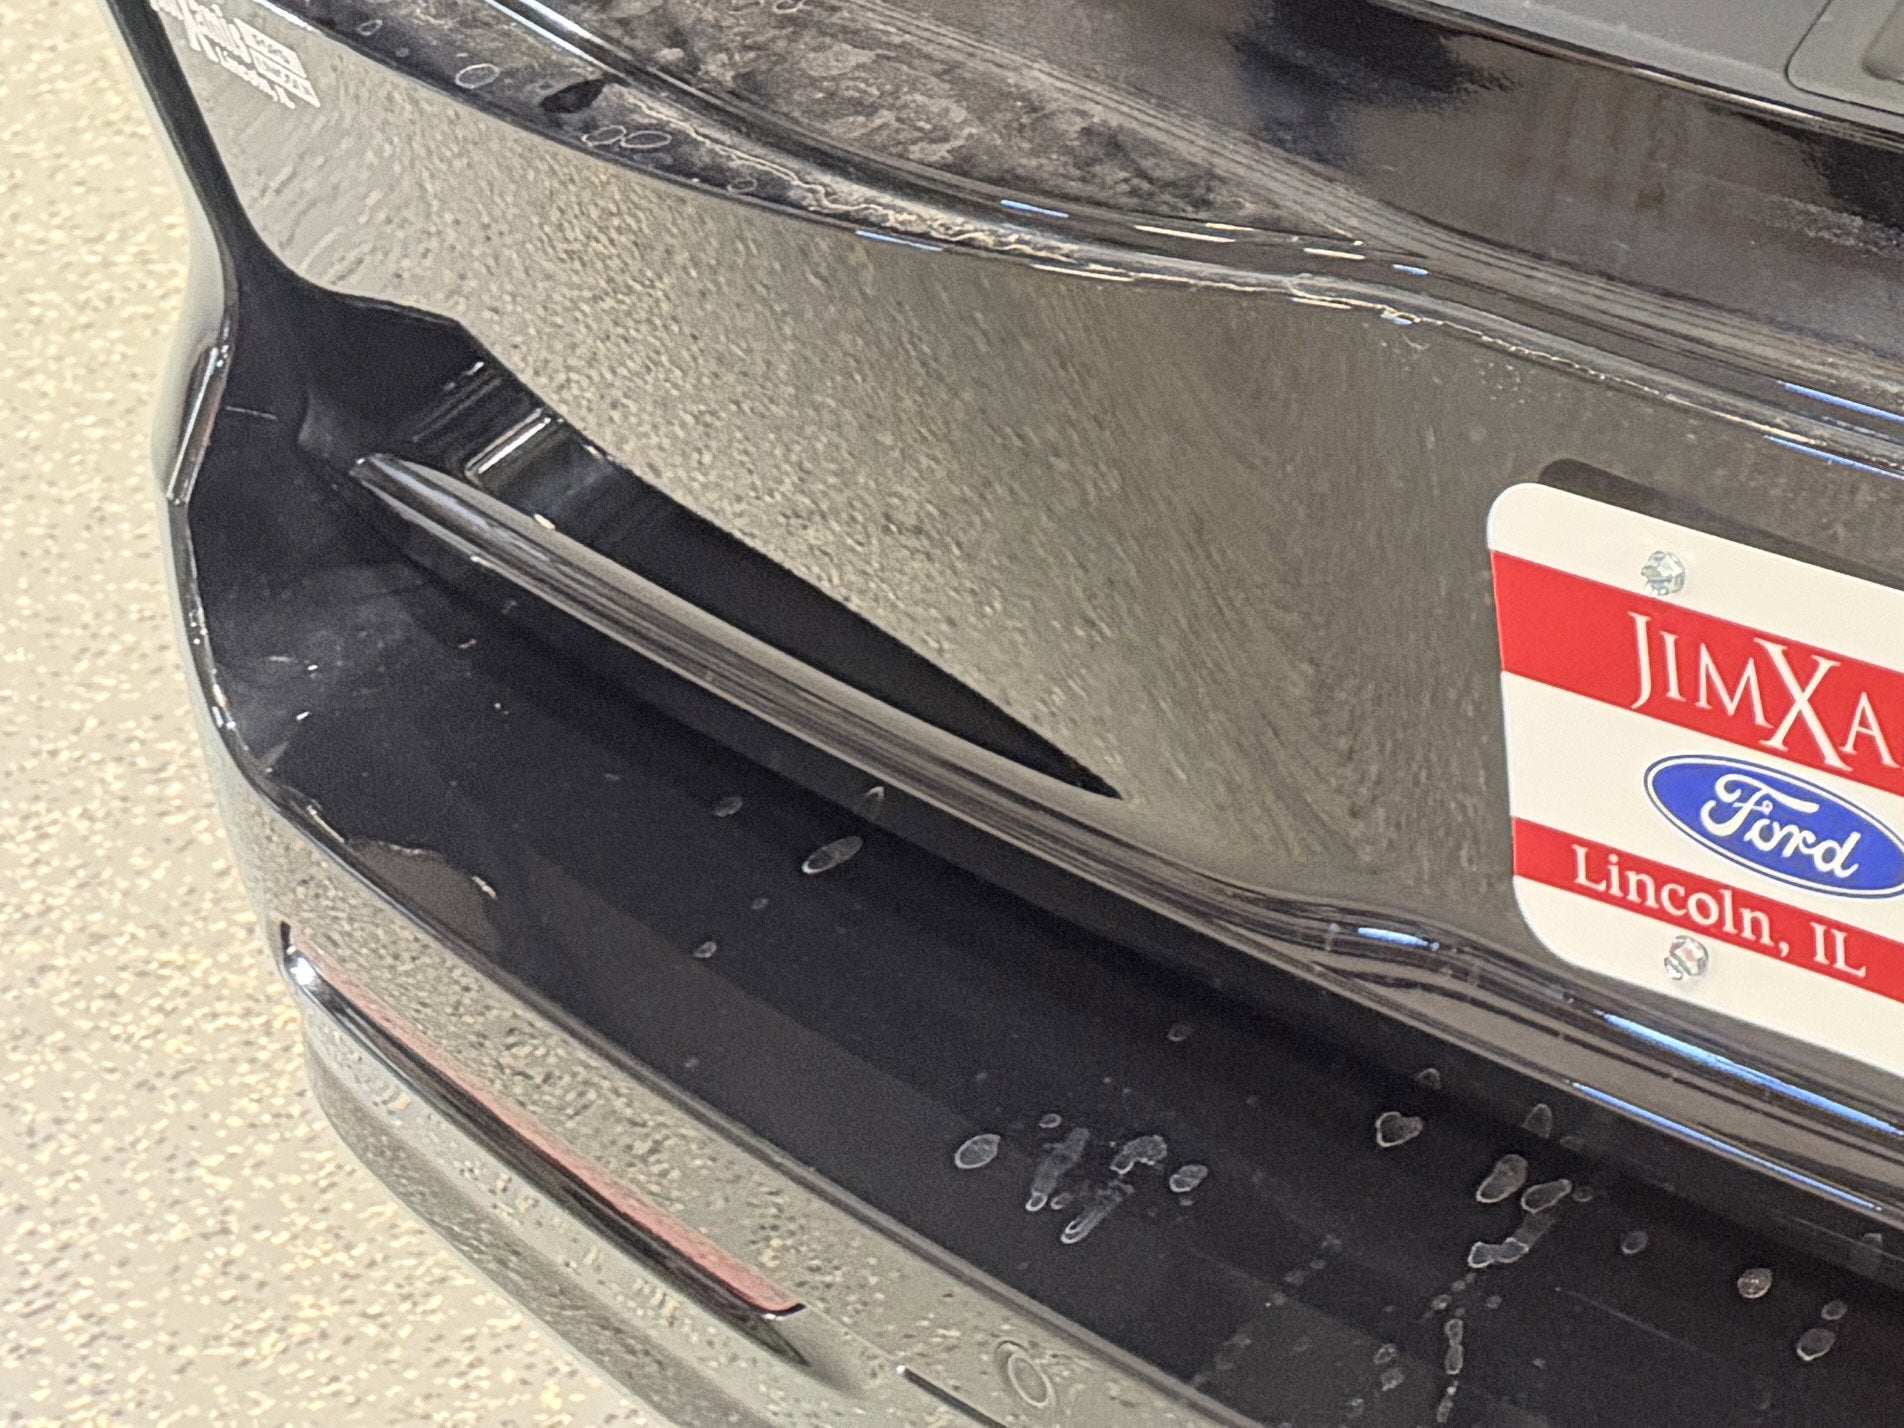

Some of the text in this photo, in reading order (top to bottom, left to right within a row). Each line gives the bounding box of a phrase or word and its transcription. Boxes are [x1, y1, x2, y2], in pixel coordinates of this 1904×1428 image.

[1700, 773, 1861, 879] Ford
[1571, 844, 1867, 978] Lincoln, IL
